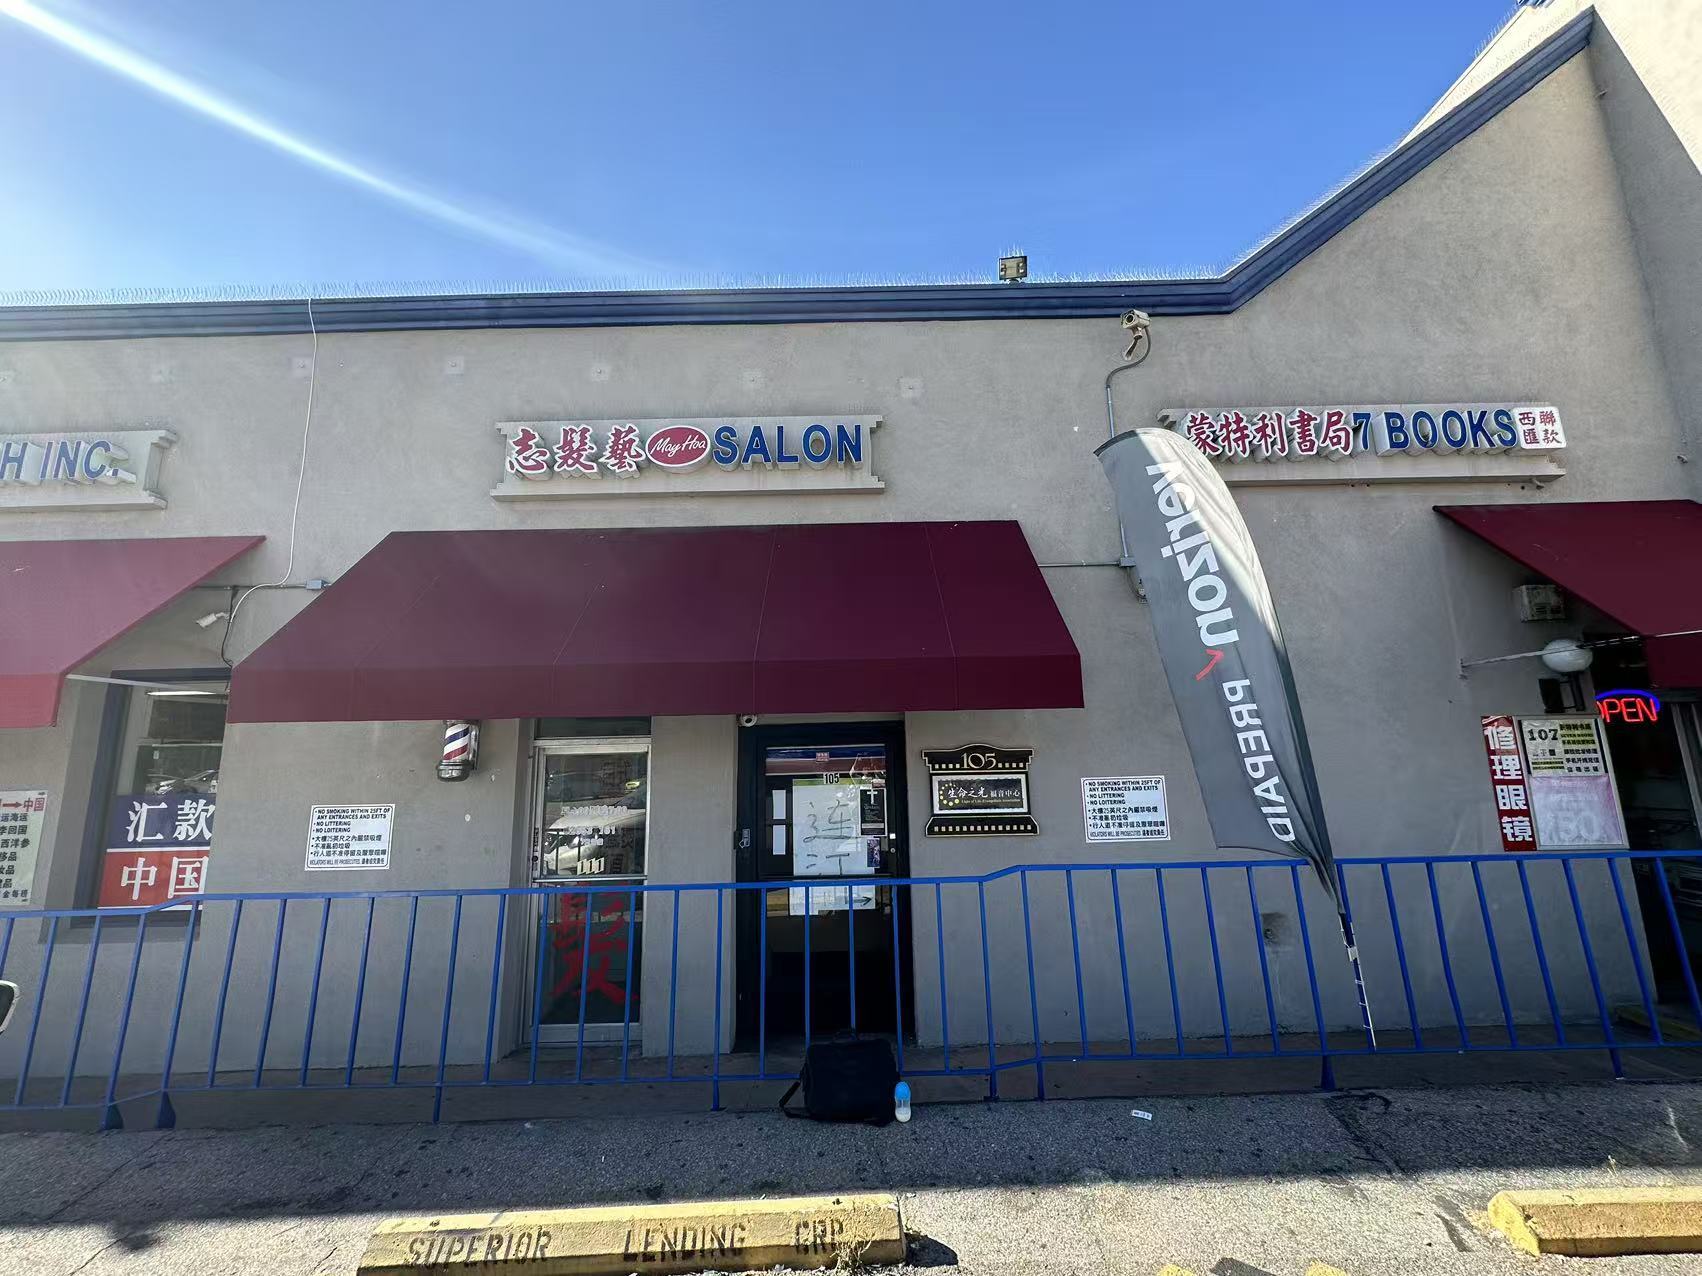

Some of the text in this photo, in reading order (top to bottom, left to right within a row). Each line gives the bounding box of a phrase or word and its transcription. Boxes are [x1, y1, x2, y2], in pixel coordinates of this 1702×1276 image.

[651, 434, 706, 458] May Hoa
[712, 424, 862, 465] SALON
[1186, 409, 1353, 456] 蒙特利書局
[1352, 409, 1518, 451] 7 BOOKS
[40, 440, 119, 480] INC.
[506, 426, 646, 473] 志髮藝
[1596, 698, 1659, 722] PEN
[1528, 728, 1558, 741] 107
[824, 772, 840, 784] 105
[961, 752, 996, 770] 105
[948, 786, 988, 798] 生命之光
[1484, 723, 1533, 842] 修理眼镜
[23, 797, 45, 812] 中国
[125, 798, 216, 843] 汇款
[0, 878, 12, 888] 品
[120, 855, 210, 901] 中国
[408, 1230, 553, 1267] SUPERIOR
[622, 1222, 747, 1263] LENDING
